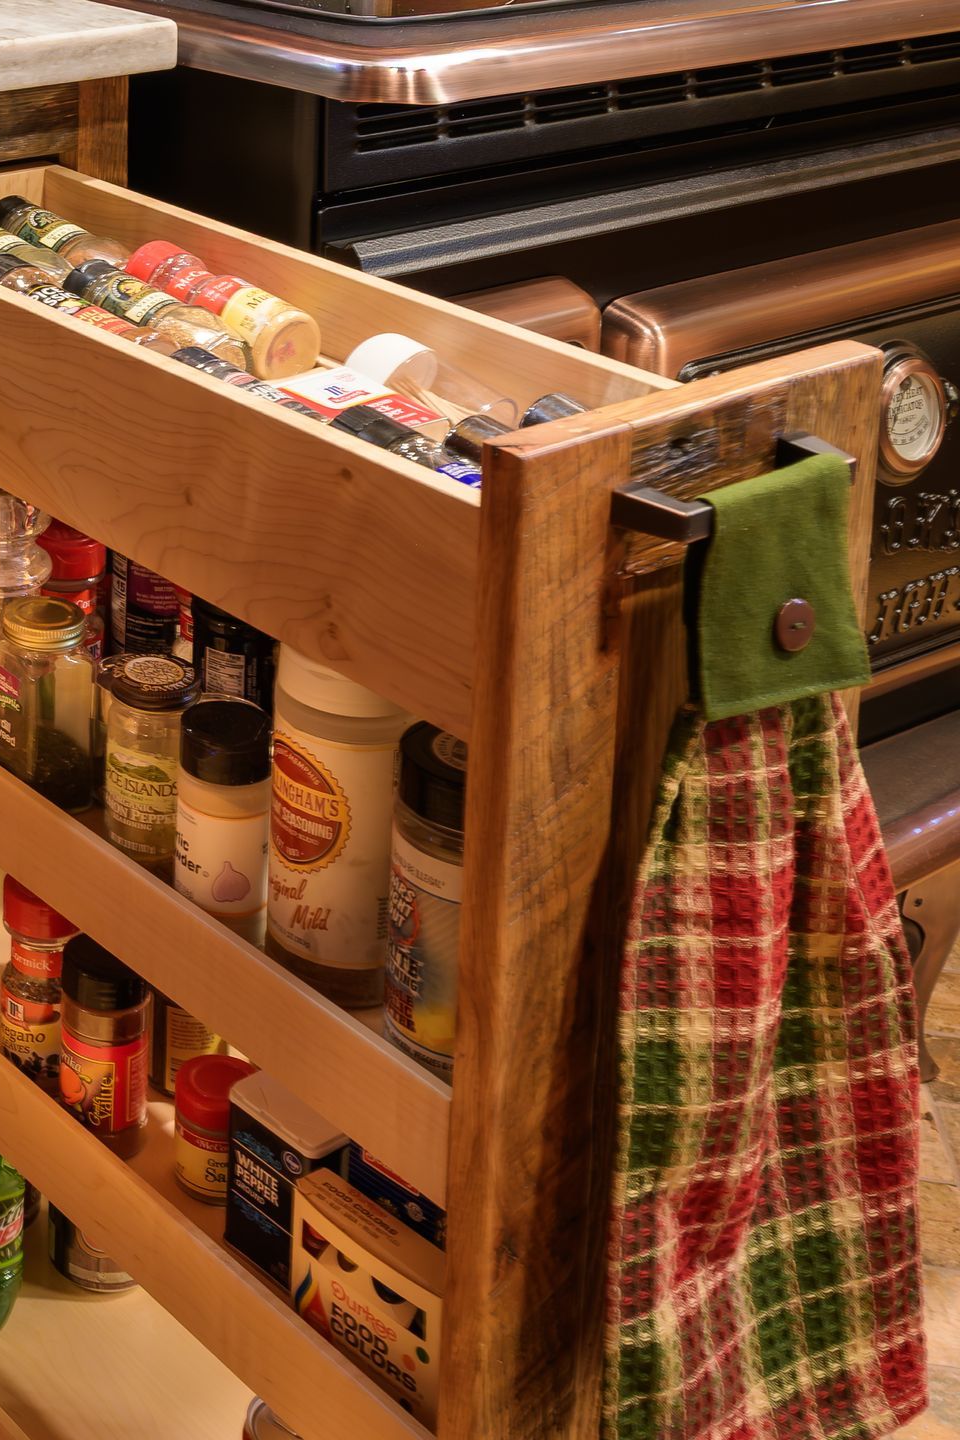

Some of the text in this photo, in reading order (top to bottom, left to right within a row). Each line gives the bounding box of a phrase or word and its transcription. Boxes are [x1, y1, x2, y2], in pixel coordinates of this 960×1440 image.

[125, 778, 178, 797] ISLANDS
[281, 806, 334, 840] SEASONING
[290, 905, 332, 931] Mild
[98, 1075, 114, 1120] Value
[235, 1149, 279, 1192] WHITE
[235, 1163, 279, 1207] PEPPER
[235, 1179, 266, 1205] GROUND
[322, 1181, 353, 1204] FOOD
[353, 1203, 399, 1236] COLORS
[331, 1280, 398, 1342] Durkee
[331, 1301, 389, 1355] FOOD
[330, 1316, 417, 1392] COLORS
